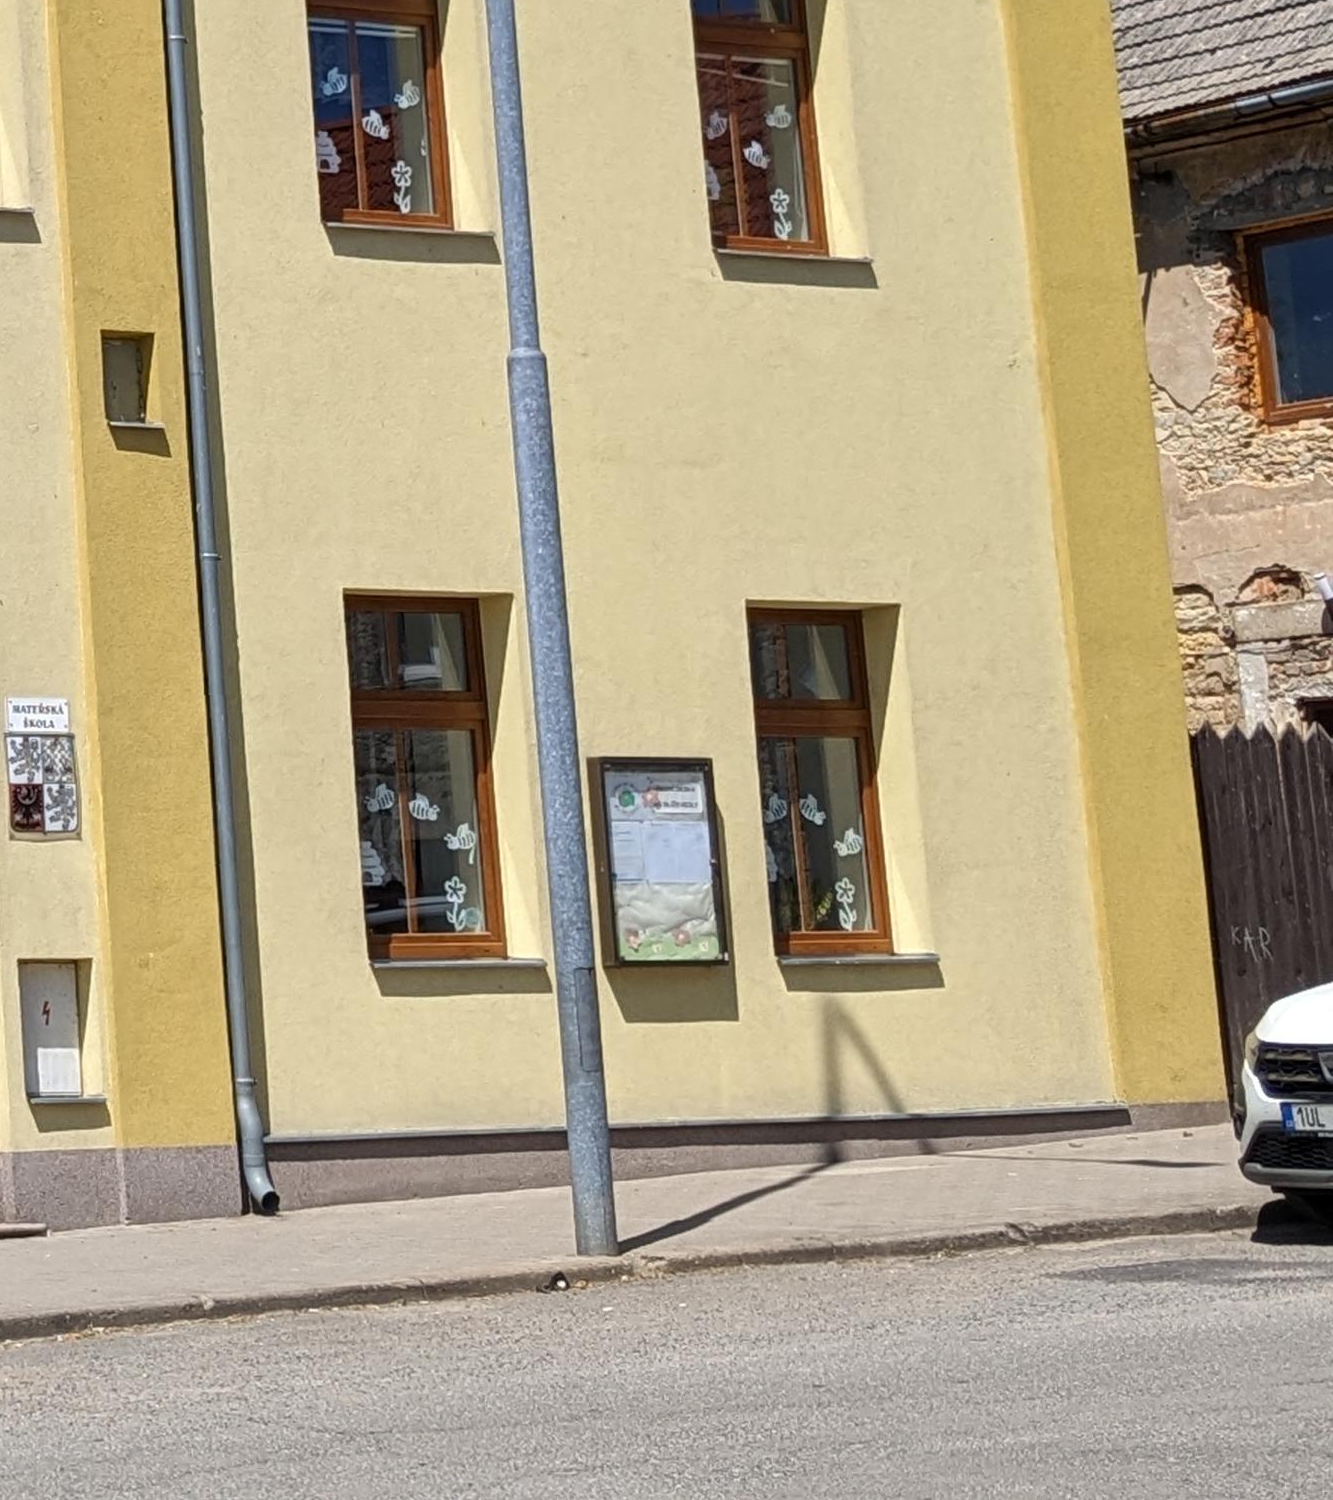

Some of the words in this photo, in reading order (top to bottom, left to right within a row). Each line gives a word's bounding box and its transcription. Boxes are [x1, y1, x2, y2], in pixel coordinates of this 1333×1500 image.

[12, 703, 64, 715] MATEŘSKÁ
[23, 716, 55, 729] ŠKOLA
[1297, 1106, 1326, 1128] 1UL
